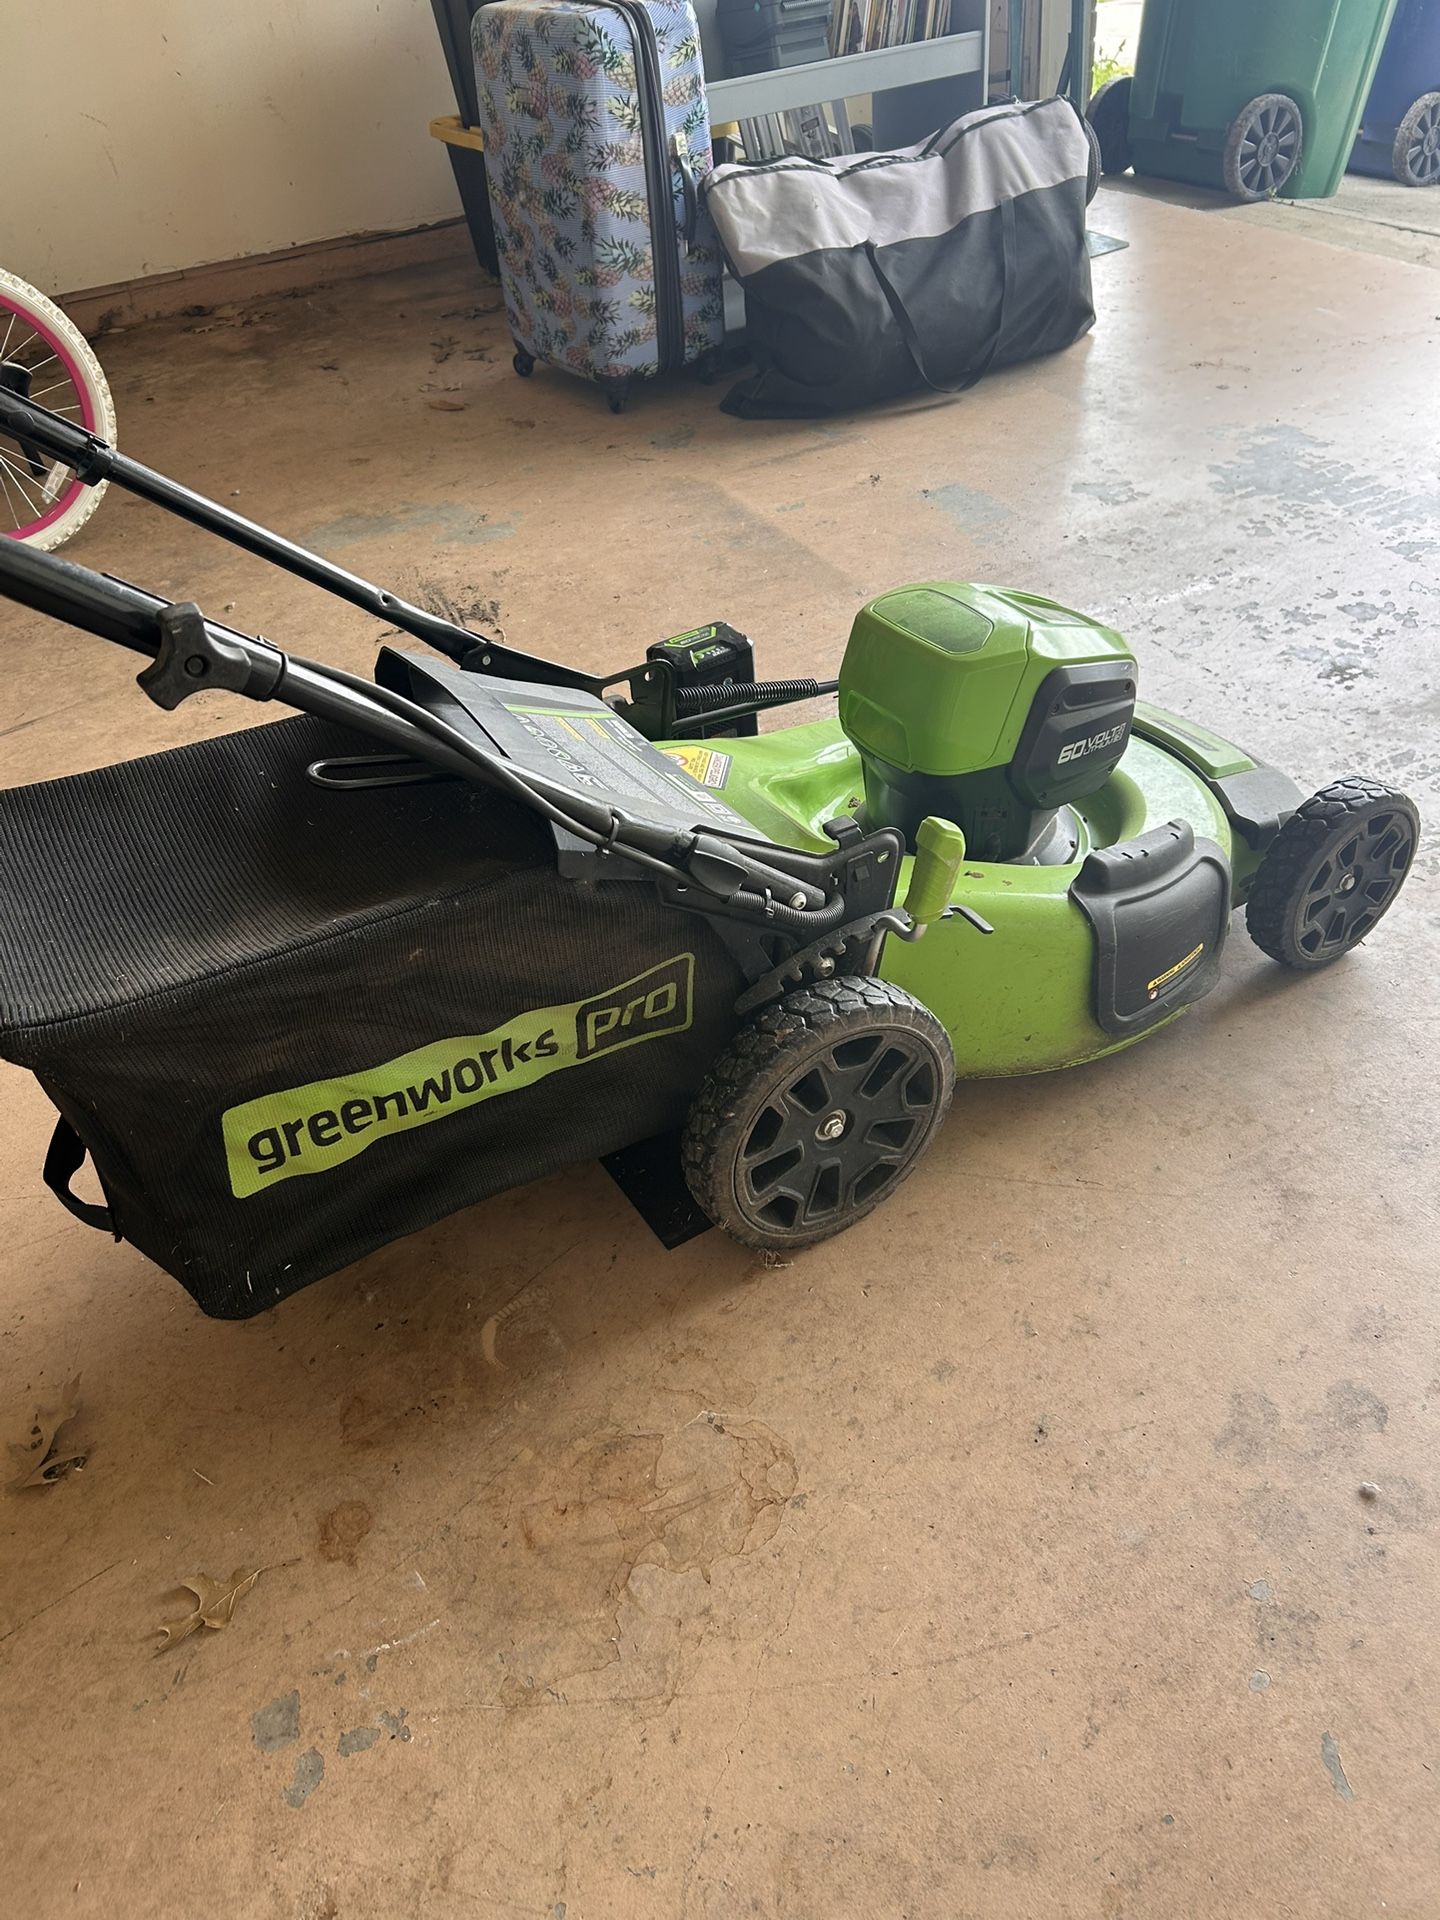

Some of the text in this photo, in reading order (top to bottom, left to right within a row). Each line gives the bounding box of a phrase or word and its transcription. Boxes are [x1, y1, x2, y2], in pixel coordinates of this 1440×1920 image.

[1057, 739, 1087, 765] 60
[1088, 725, 1121, 747] VOLT
[247, 982, 677, 1175] greenworks pro
